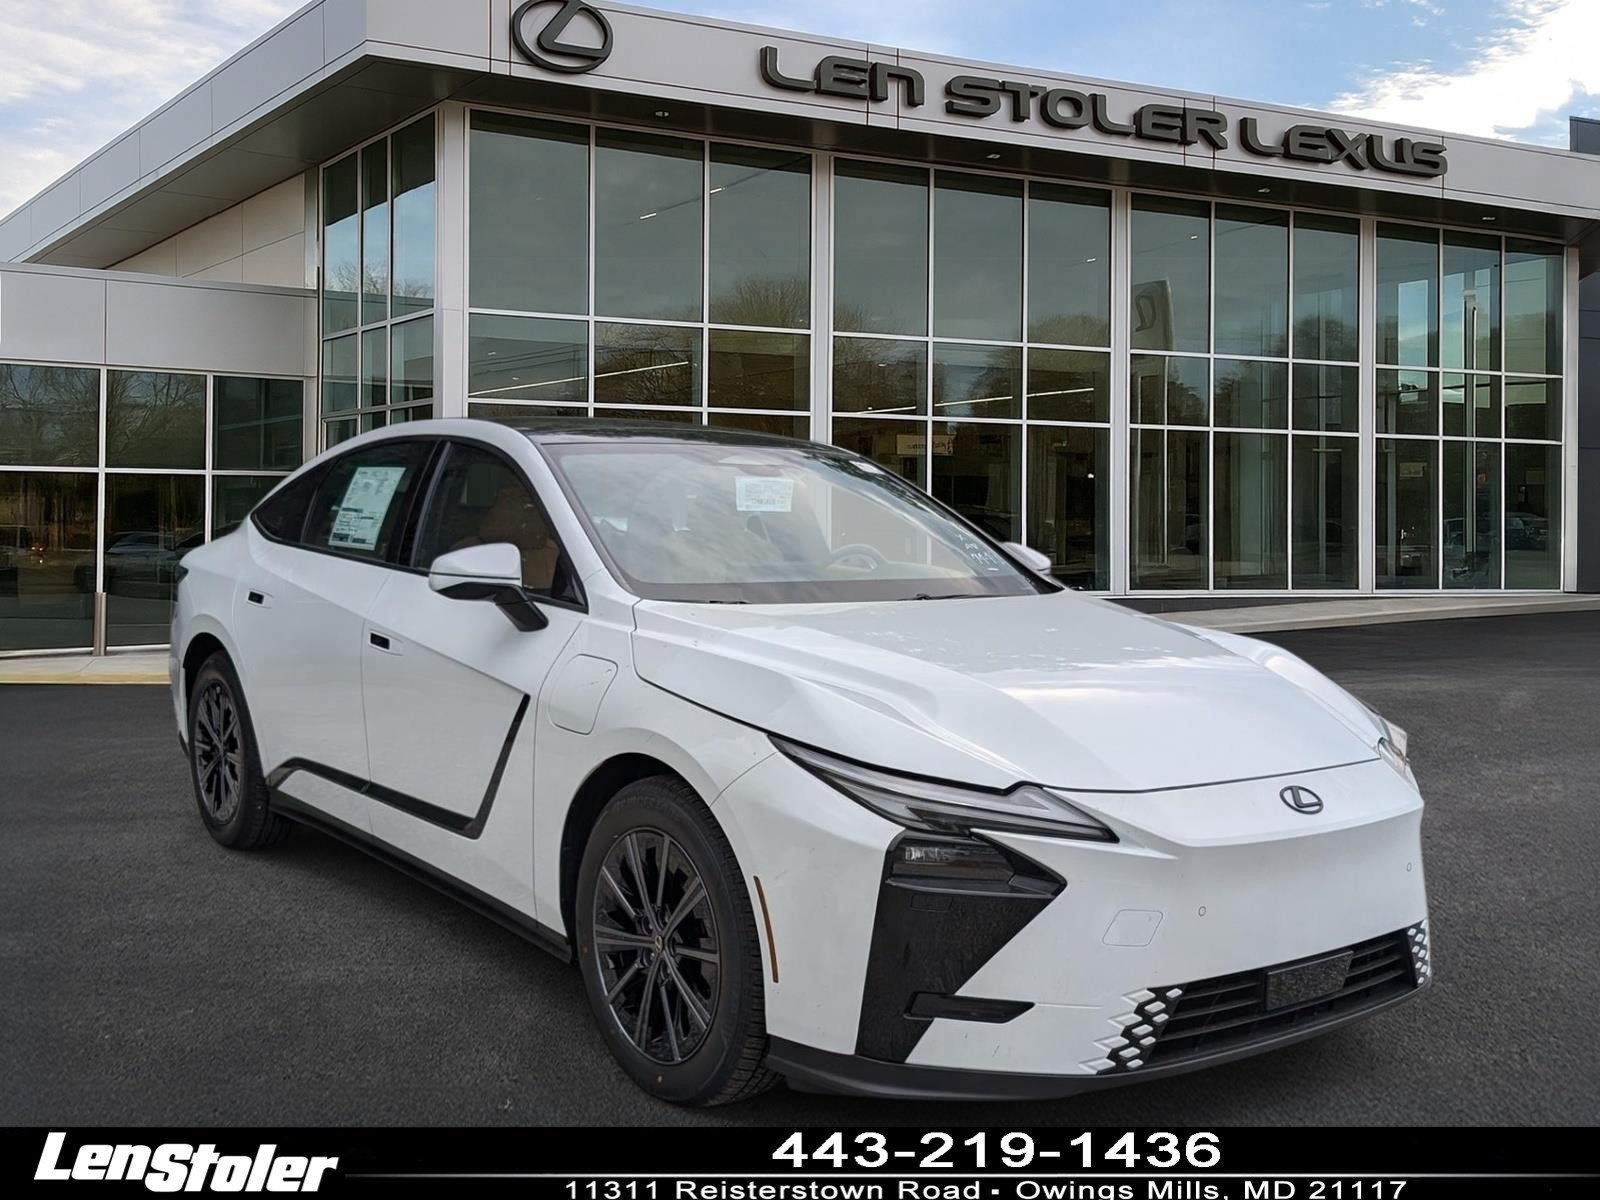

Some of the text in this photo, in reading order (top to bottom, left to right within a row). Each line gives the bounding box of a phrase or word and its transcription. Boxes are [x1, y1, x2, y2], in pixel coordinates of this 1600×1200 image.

[760, 46, 1448, 178] LEN STOLER LEXUS
